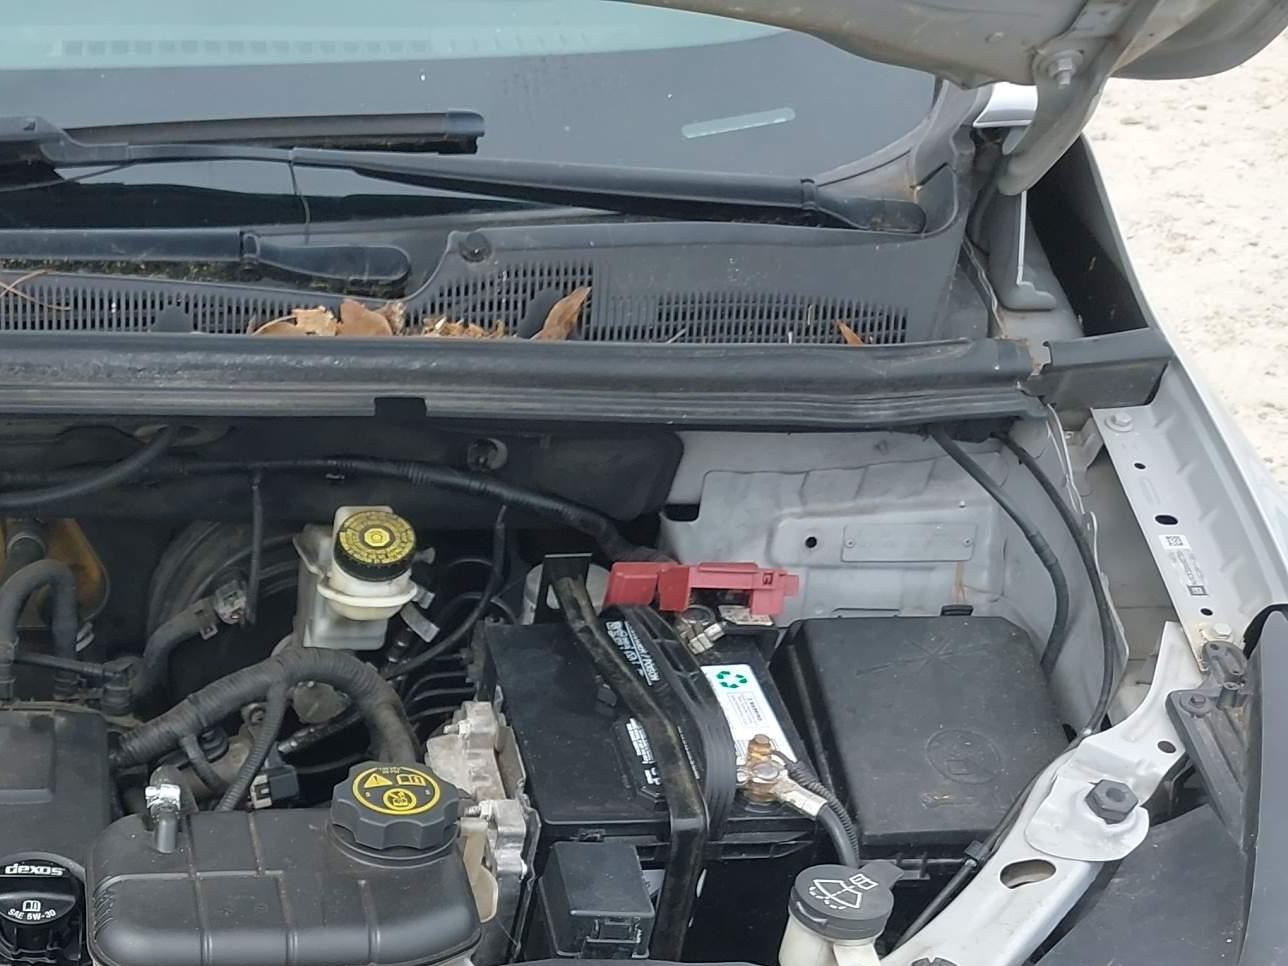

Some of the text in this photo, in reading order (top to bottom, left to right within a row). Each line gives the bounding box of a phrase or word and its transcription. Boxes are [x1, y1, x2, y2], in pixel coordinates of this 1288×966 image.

[4, 863, 66, 876] dexos
[7, 908, 57, 921] SAE 5W-30
